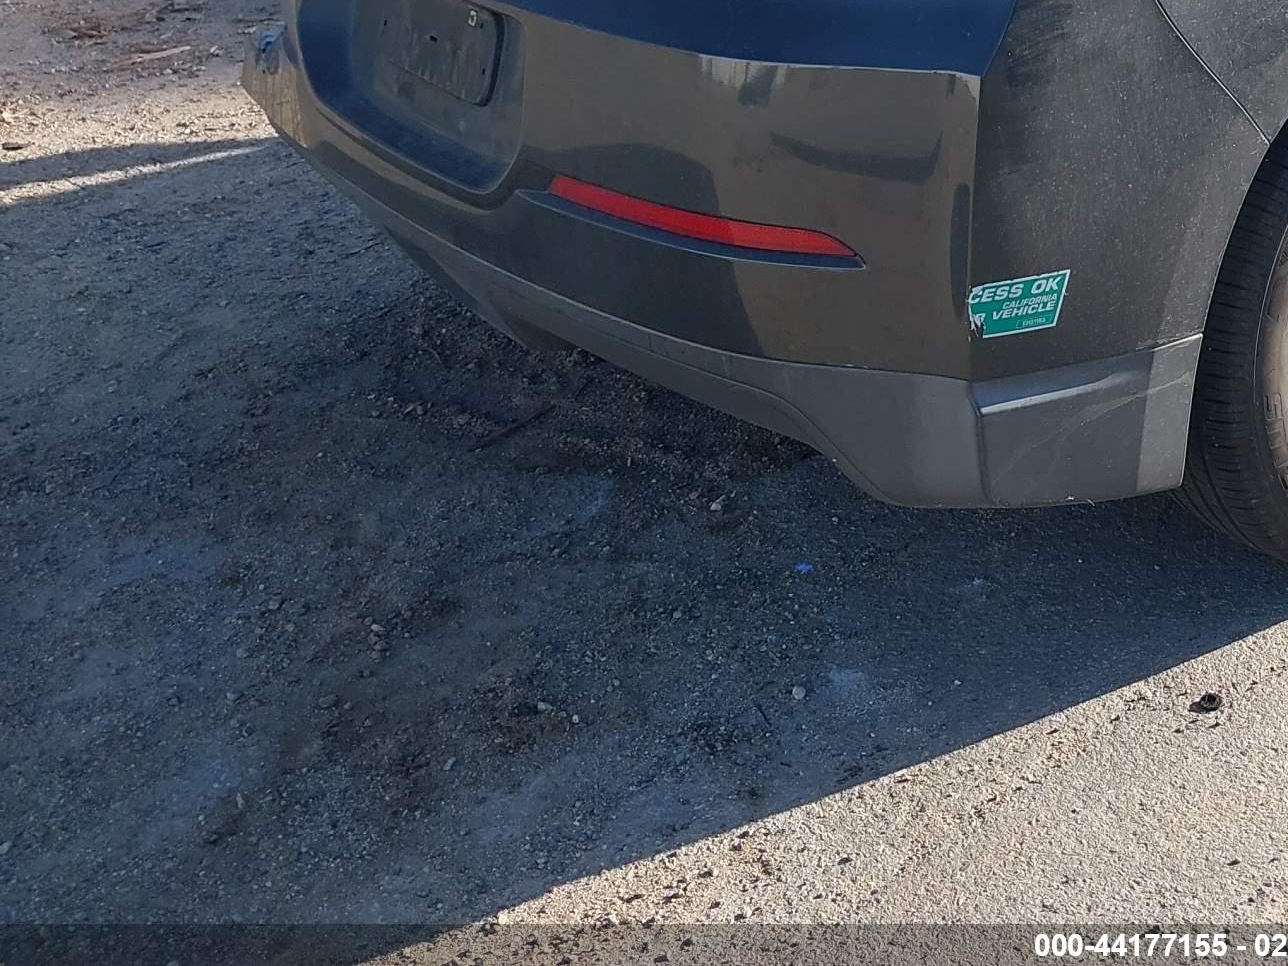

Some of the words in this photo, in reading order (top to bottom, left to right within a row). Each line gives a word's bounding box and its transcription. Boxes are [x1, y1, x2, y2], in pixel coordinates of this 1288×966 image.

[1031, 276, 1063, 294] OK
[1002, 292, 1058, 310] CALIFORNIA
[992, 300, 1056, 321] VEHICLE
